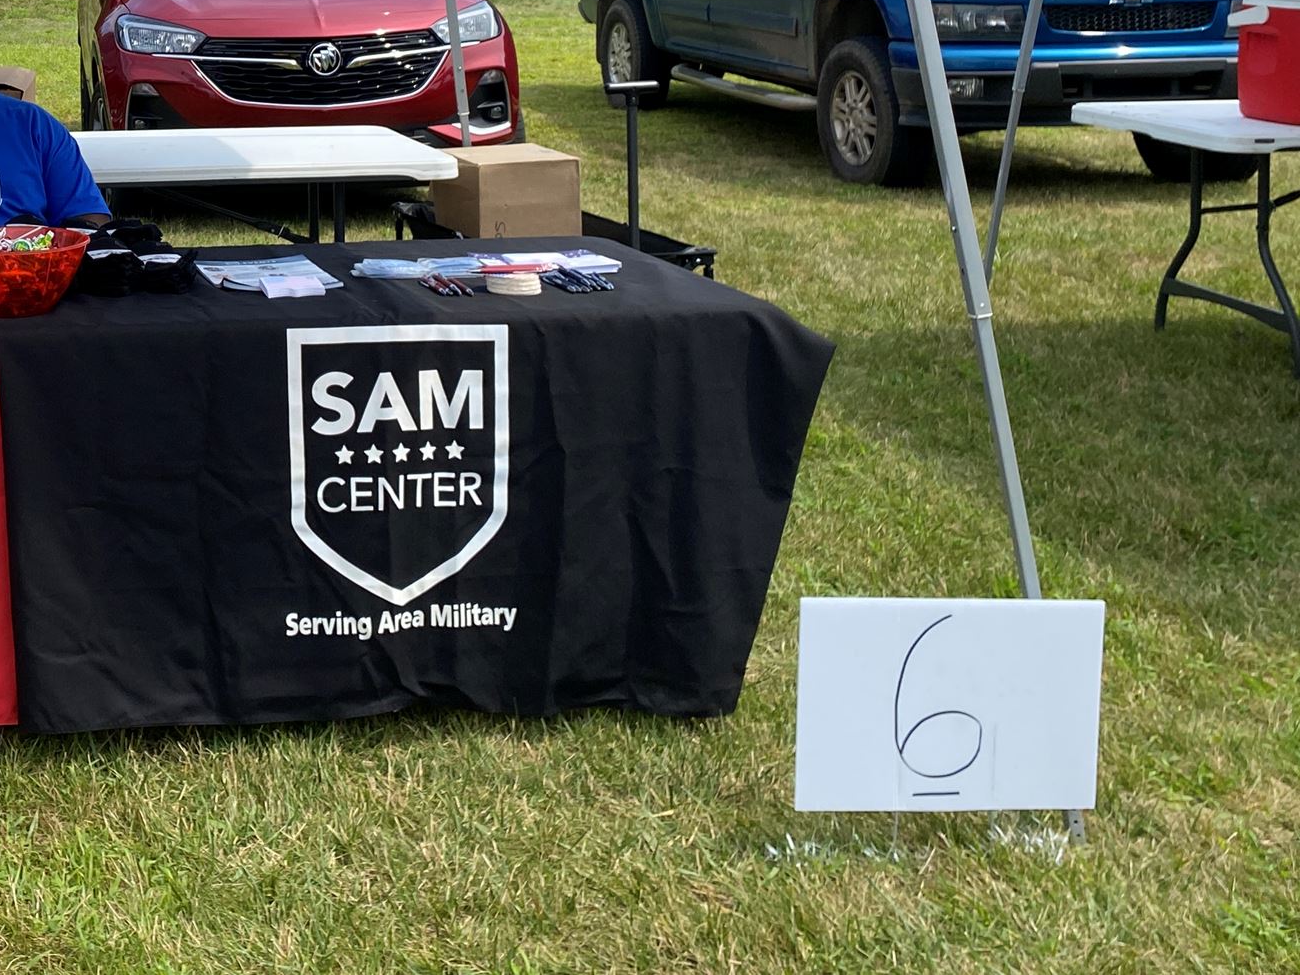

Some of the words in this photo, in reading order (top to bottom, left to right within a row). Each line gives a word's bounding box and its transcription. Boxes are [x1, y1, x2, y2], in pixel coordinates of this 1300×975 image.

[311, 369, 485, 436] SAM
[317, 472, 483, 513] CENTER
[285, 611, 372, 641] Serving
[378, 609, 424, 634] Area
[430, 603, 517, 631] Military
[894, 613, 983, 779] 6
